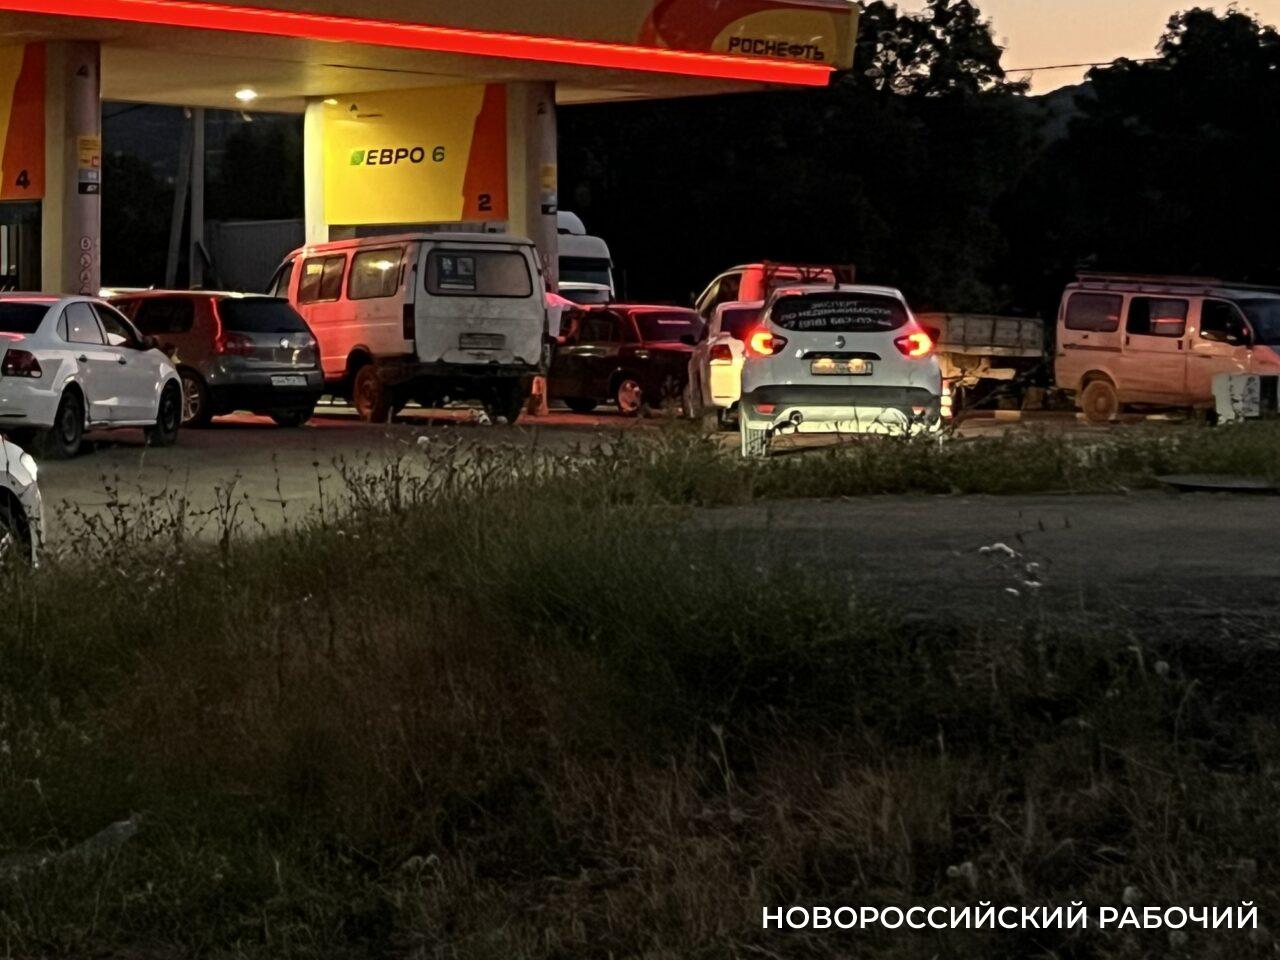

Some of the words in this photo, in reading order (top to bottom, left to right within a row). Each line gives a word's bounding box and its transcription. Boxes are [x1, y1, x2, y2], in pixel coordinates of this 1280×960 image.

[728, 36, 824, 60] РОСНЕФТЬ
[365, 146, 425, 166] ЕВРО
[431, 146, 445, 162] 6
[16, 169, 30, 189] 4
[477, 193, 493, 211] 2
